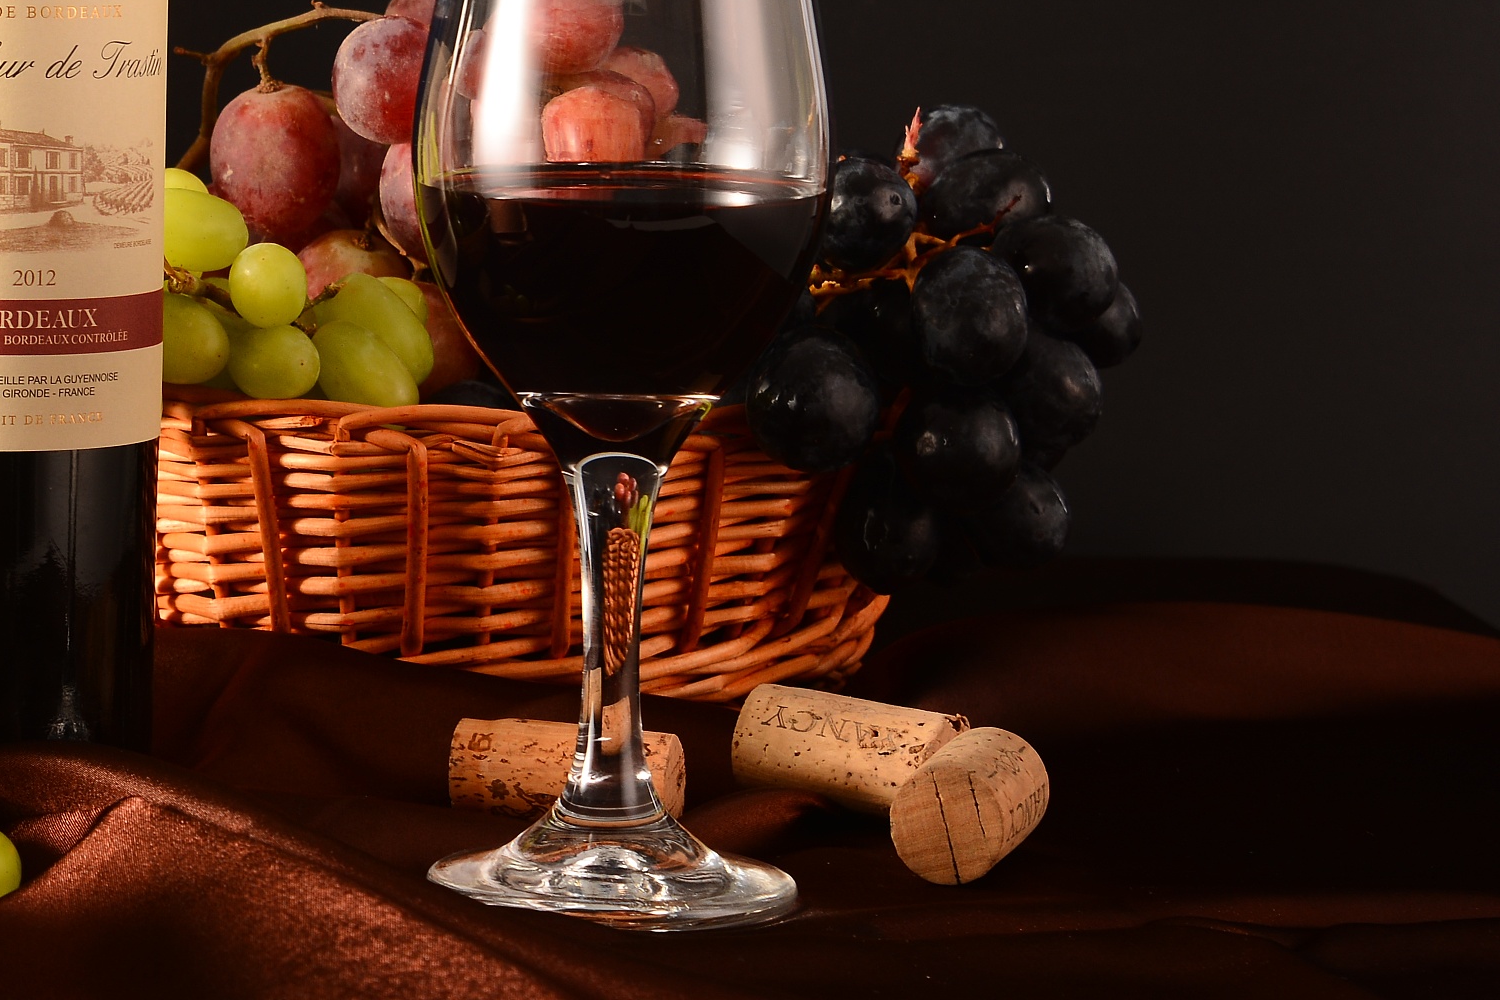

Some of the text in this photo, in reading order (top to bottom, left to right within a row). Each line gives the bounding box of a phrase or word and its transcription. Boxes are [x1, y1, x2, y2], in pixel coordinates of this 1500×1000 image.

[26, 4, 123, 19] BORDEAUX
[45, 44, 81, 79] de
[93, 40, 163, 80] Trastin
[12, 269, 56, 286] 2012
[4, 334, 69, 346] BORDEAUX
[27, 375, 48, 384] PAR
[50, 375, 62, 384] LA
[63, 372, 119, 384] GUYENNOISE
[2, 389, 50, 398] GIRONDE
[58, 387, 95, 398] FRANCE
[24, 414, 44, 426] DE
[50, 412, 103, 425] FRANCE
